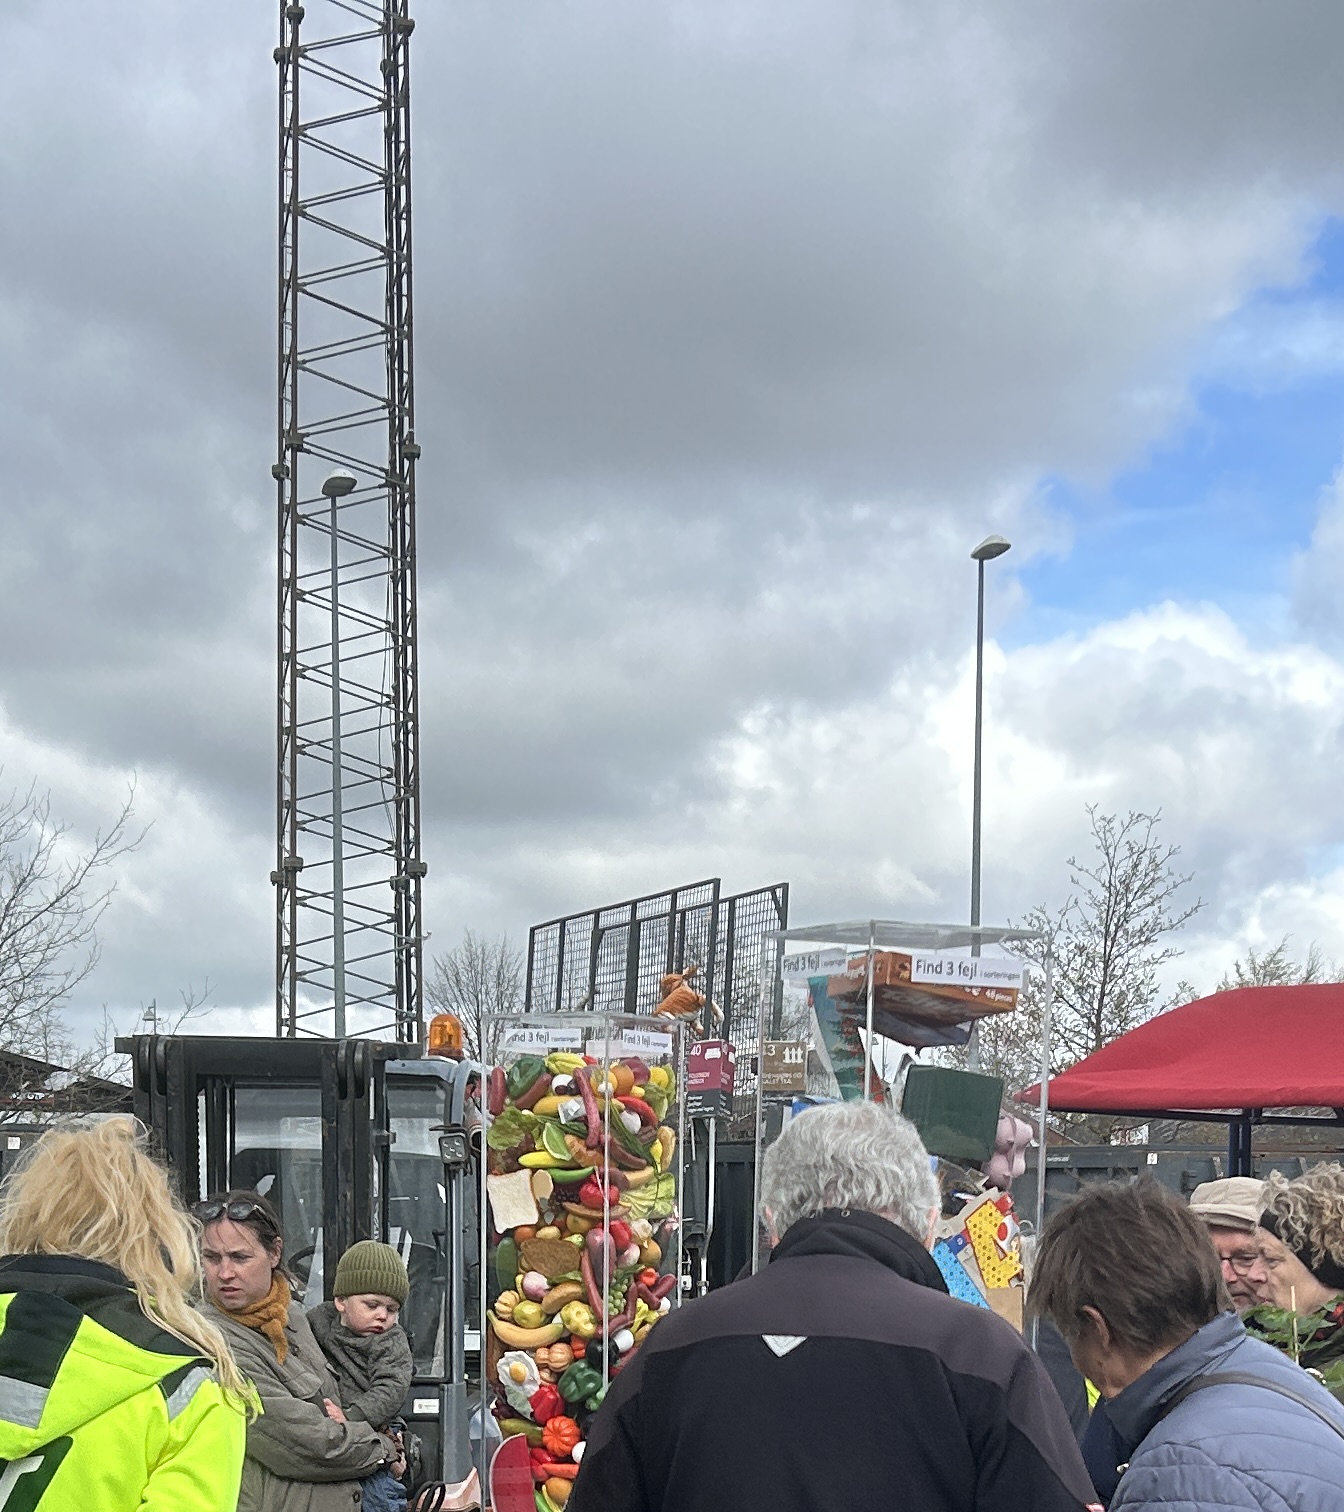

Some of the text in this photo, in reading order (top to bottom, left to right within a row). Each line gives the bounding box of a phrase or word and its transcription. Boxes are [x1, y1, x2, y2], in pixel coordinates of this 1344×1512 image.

[916, 958, 943, 976] Find
[946, 960, 954, 974] 3
[958, 961, 978, 981] fejl
[528, 1031, 534, 1043] 3
[690, 1044, 702, 1057] 40
